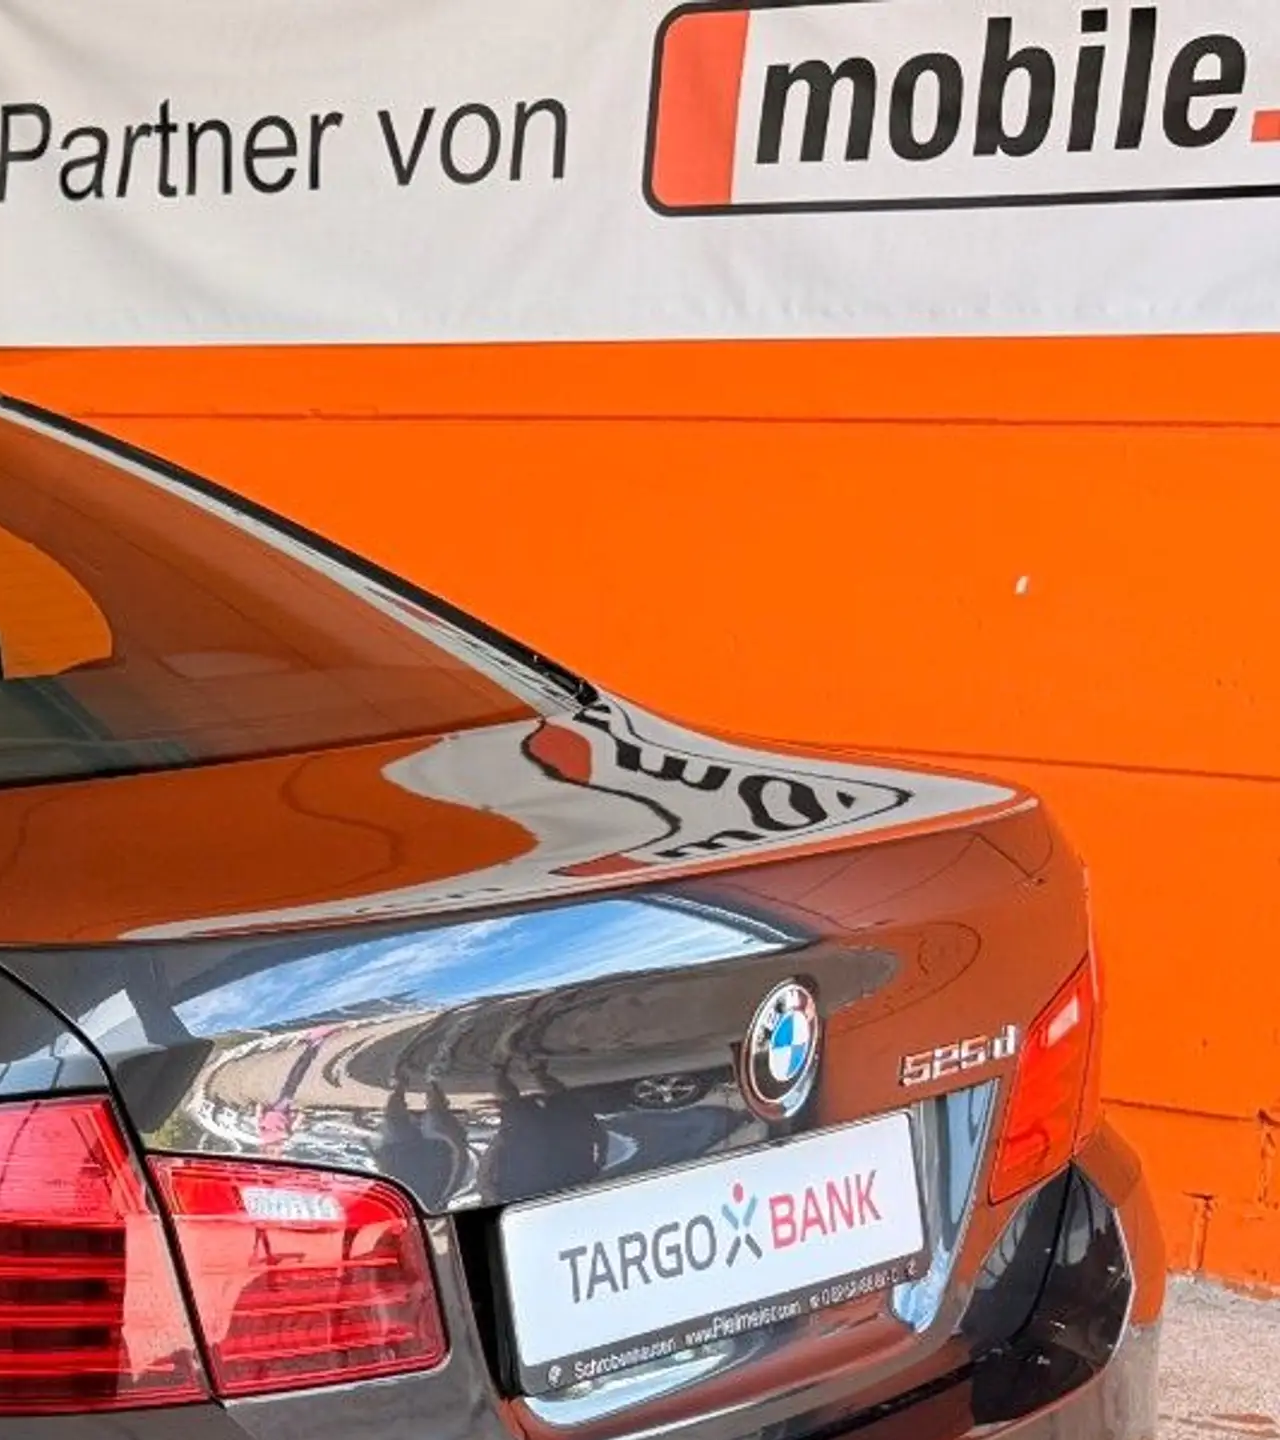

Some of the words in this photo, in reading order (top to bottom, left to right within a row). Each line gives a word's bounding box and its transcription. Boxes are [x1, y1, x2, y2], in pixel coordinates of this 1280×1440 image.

[377, 97, 568, 186] von
[898, 1024, 1017, 1087] 525d
[768, 1169, 883, 1249] BANK
